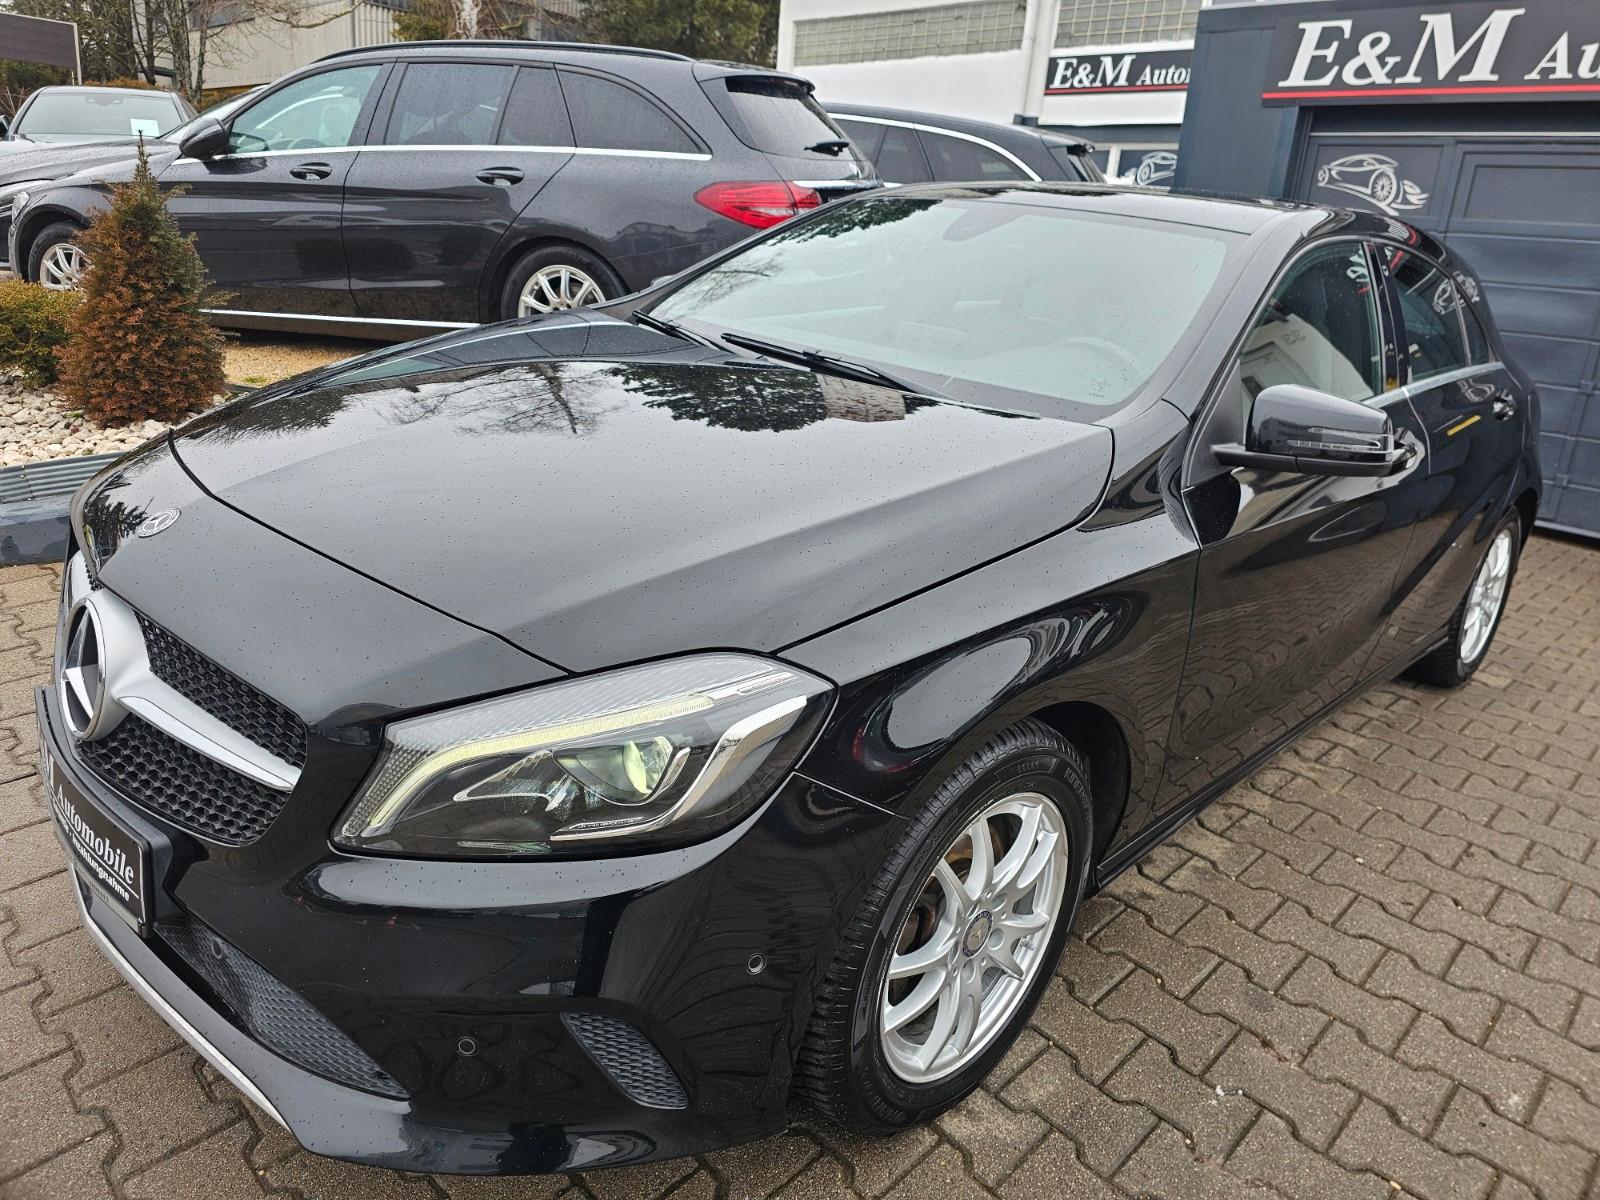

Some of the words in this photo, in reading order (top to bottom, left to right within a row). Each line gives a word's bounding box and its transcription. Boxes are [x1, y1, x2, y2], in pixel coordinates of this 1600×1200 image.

[1049, 54, 1137, 89] E&M
[1277, 7, 1526, 88] E&M
[56, 784, 134, 884] Automobile
[72, 832, 130, 902] Inzahlungnahme
